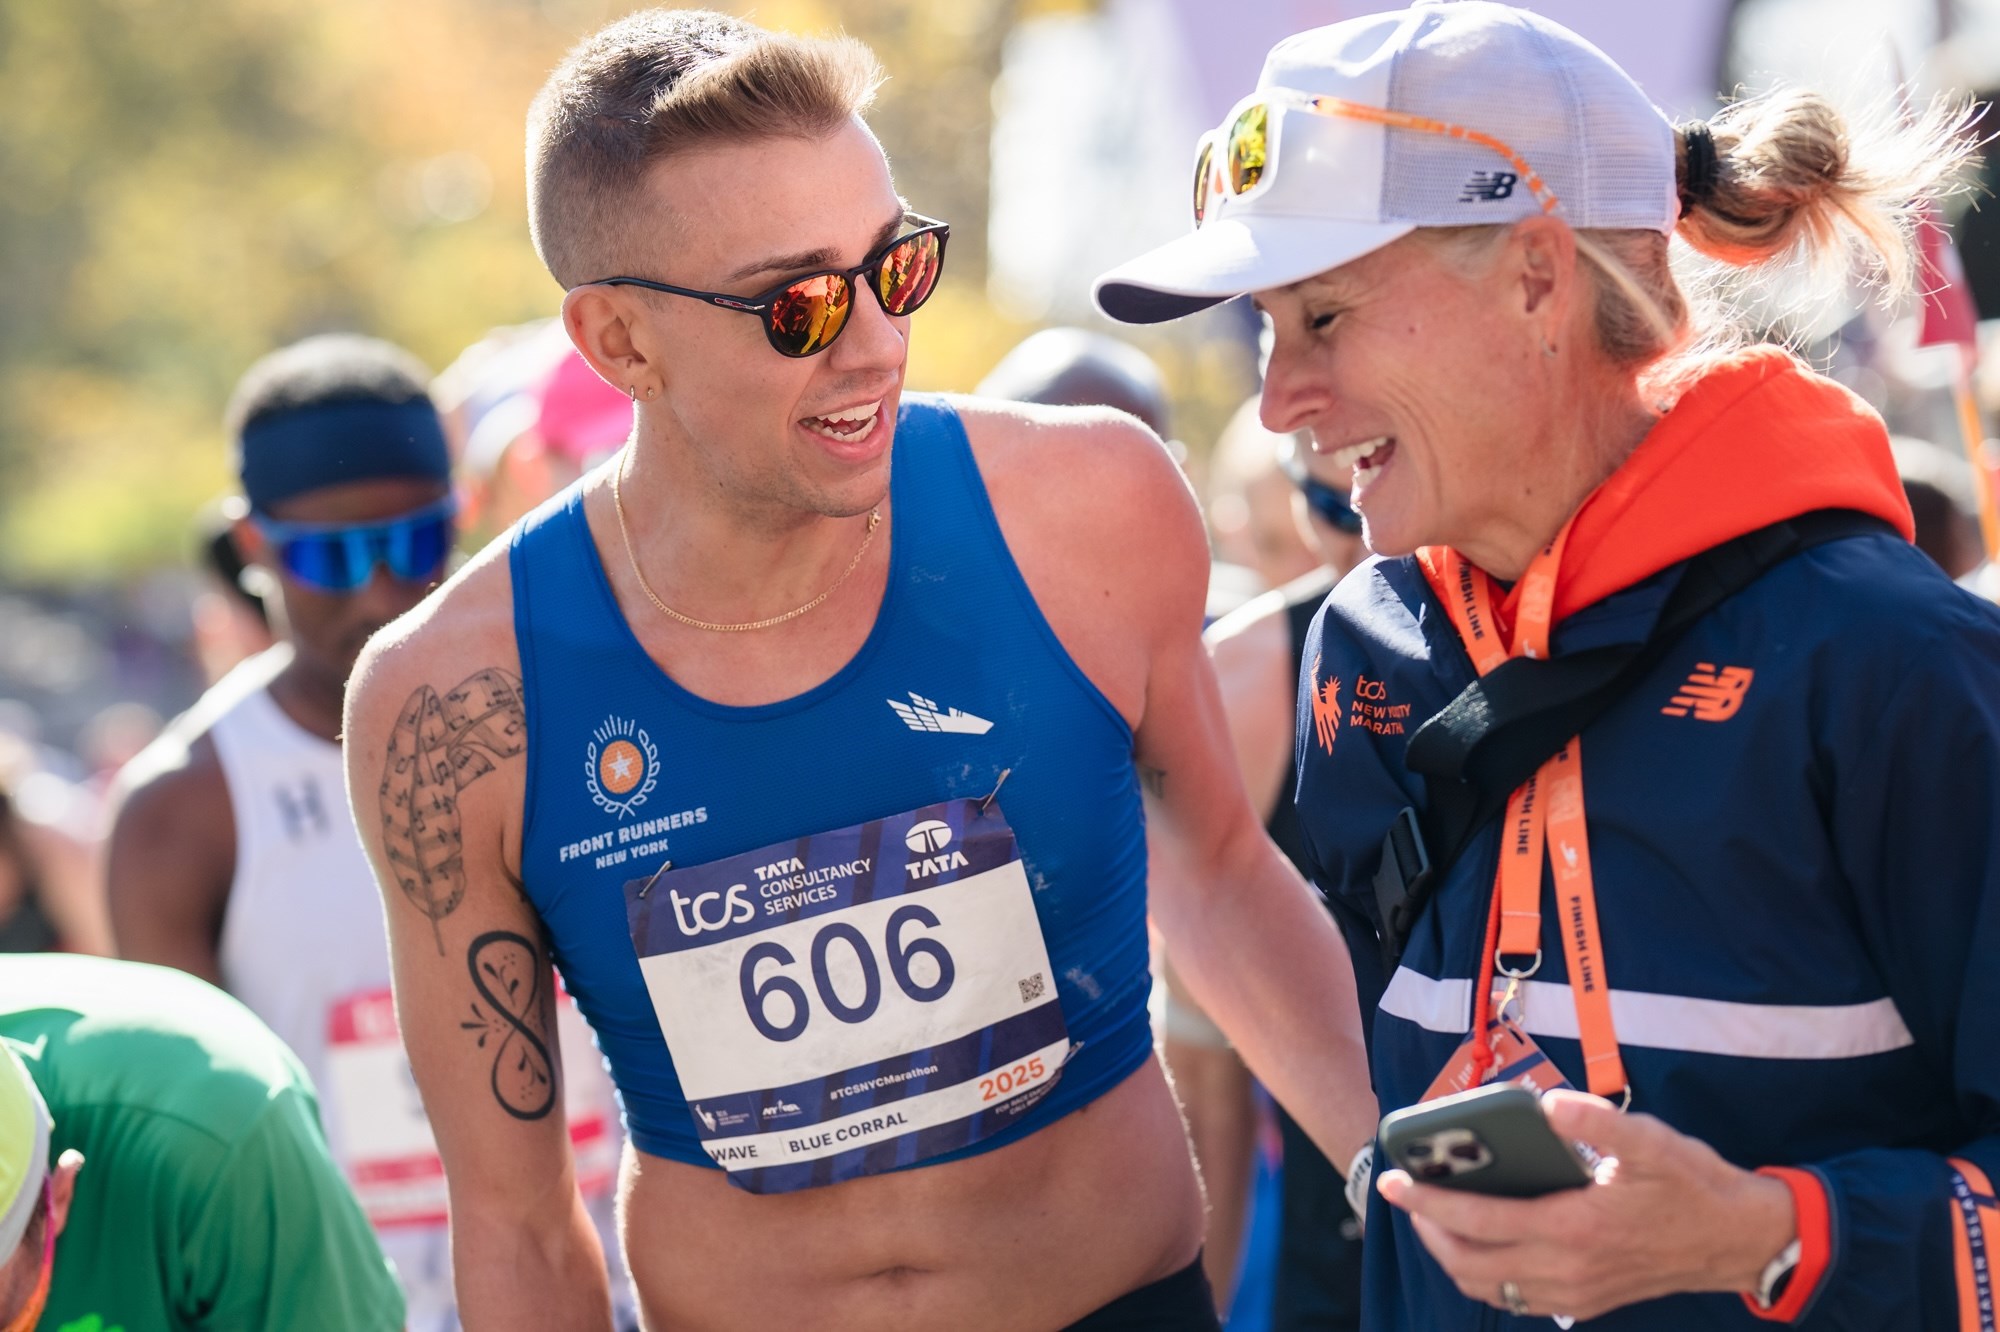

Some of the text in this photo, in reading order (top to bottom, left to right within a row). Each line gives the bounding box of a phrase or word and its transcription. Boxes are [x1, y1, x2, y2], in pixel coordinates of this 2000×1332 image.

[1466, 605, 1485, 640] LINE
[1356, 675, 1387, 700] tcs
[1351, 700, 1386, 719] NEW
[559, 807, 708, 862] FRONT RUNNERS
[1517, 818, 1530, 855] LINE
[596, 838, 669, 869] NEW YORK
[754, 857, 805, 881] TATA
[905, 850, 969, 880] TATA
[760, 858, 872, 898] CONSULTANCY
[670, 883, 755, 936] tcs
[764, 885, 838, 916] SERVICES
[1570, 896, 1588, 952] FINISH
[1579, 955, 1595, 993] LINE
[739, 905, 955, 1043] 606
[830, 1064, 938, 1101] #TCSNYCMarathon
[979, 1057, 1045, 1101] 2025
[789, 1112, 908, 1153] BLUE CORRAL
[711, 1145, 758, 1161] WAVE
